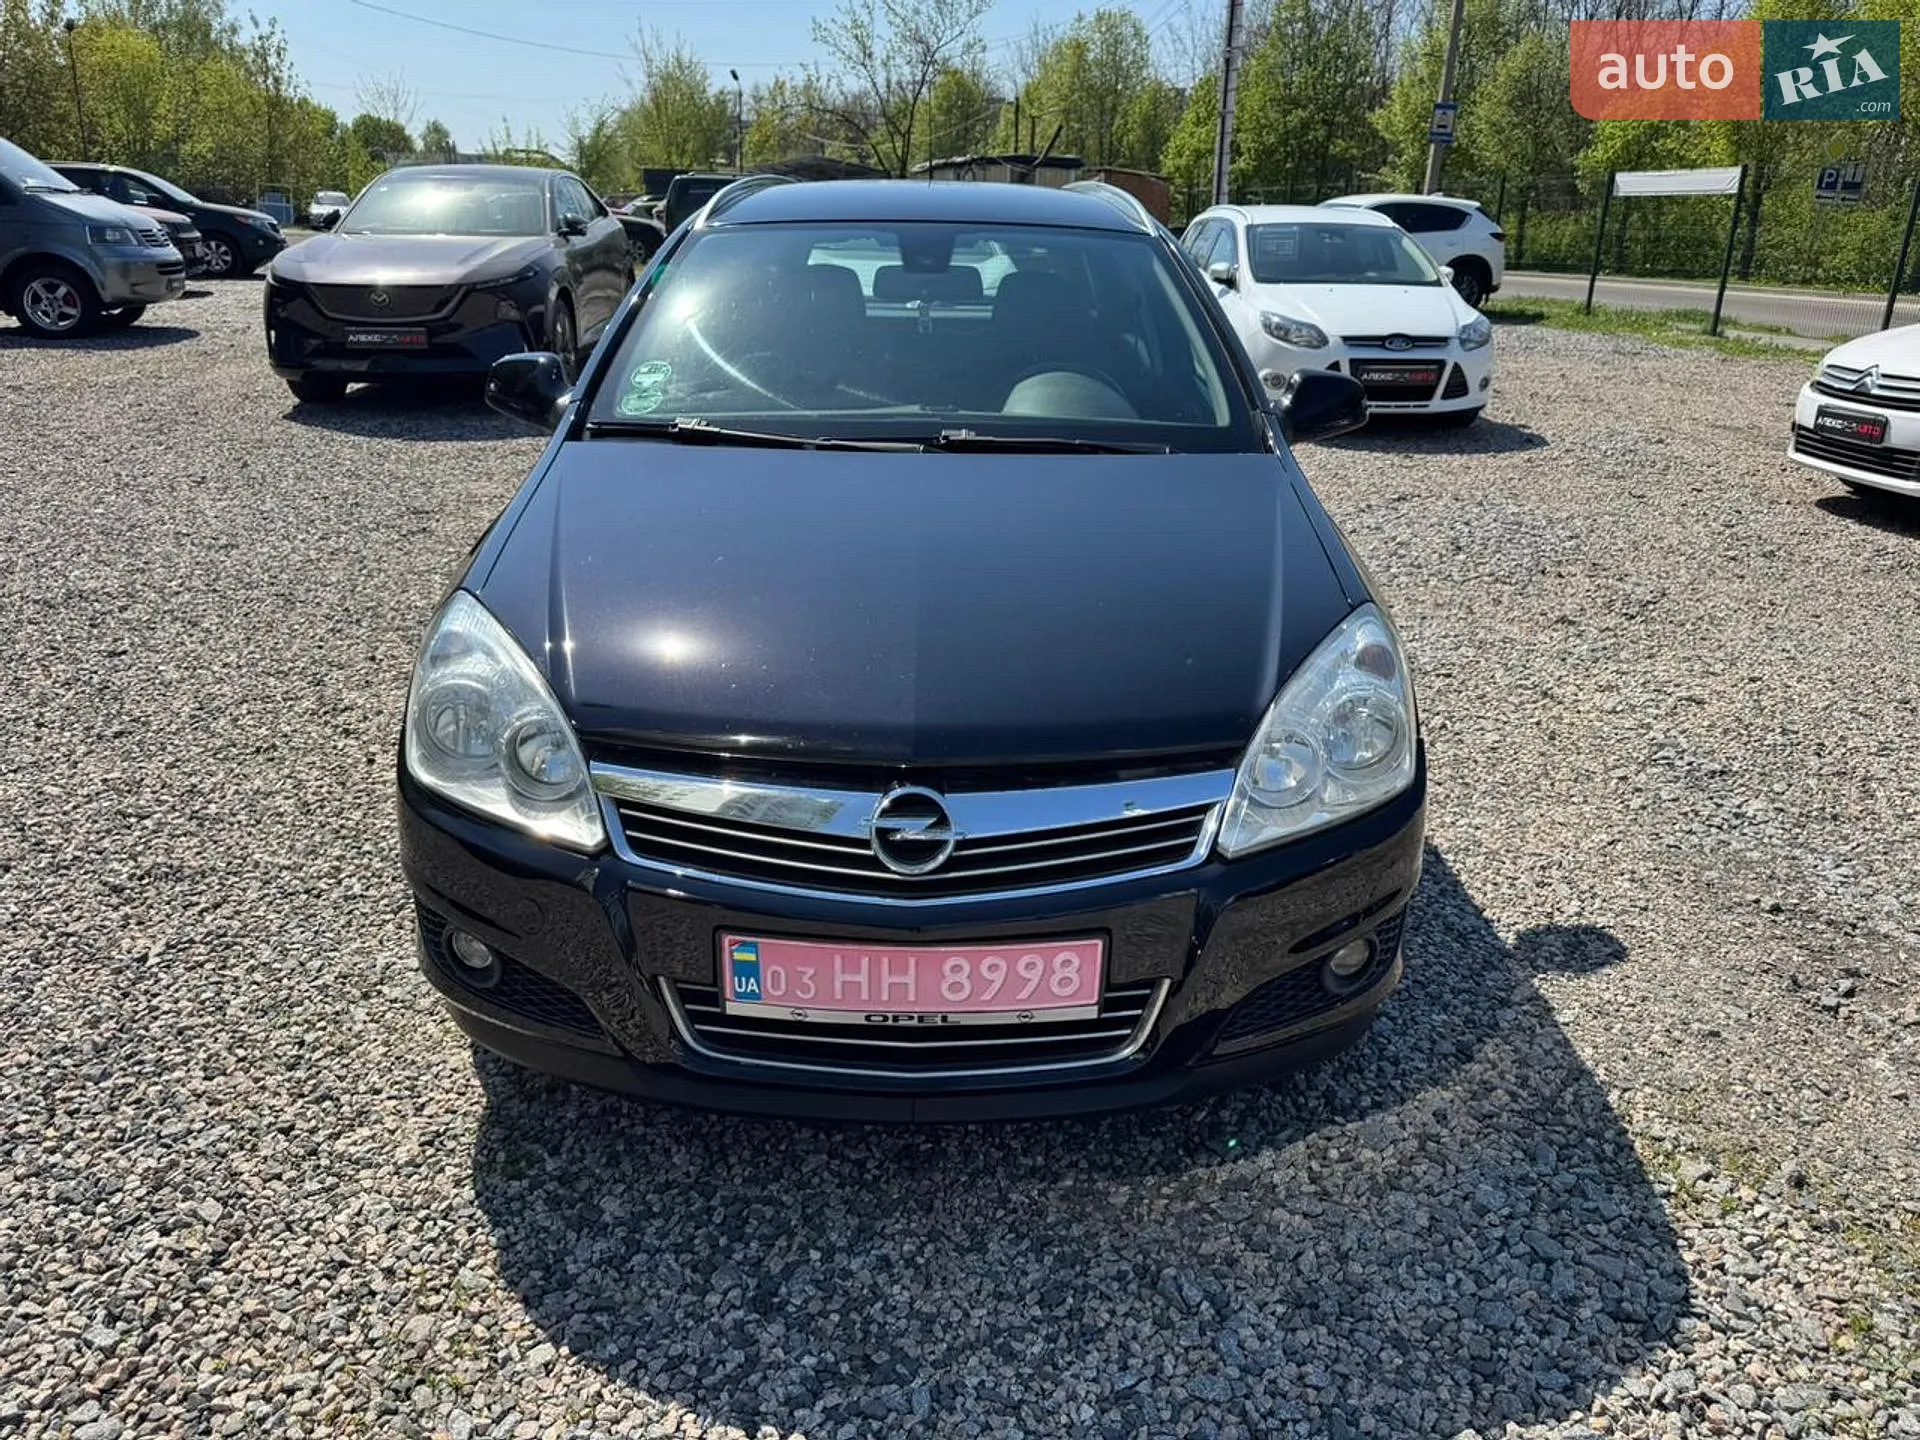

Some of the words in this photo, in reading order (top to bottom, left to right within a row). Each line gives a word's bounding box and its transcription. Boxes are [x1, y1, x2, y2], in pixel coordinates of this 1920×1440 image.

[1822, 169, 1837, 188] P
[734, 975, 759, 994] UA
[766, 964, 816, 999] 03
[940, 951, 1082, 1001] 8998
[864, 1013, 961, 1025] OPEL
